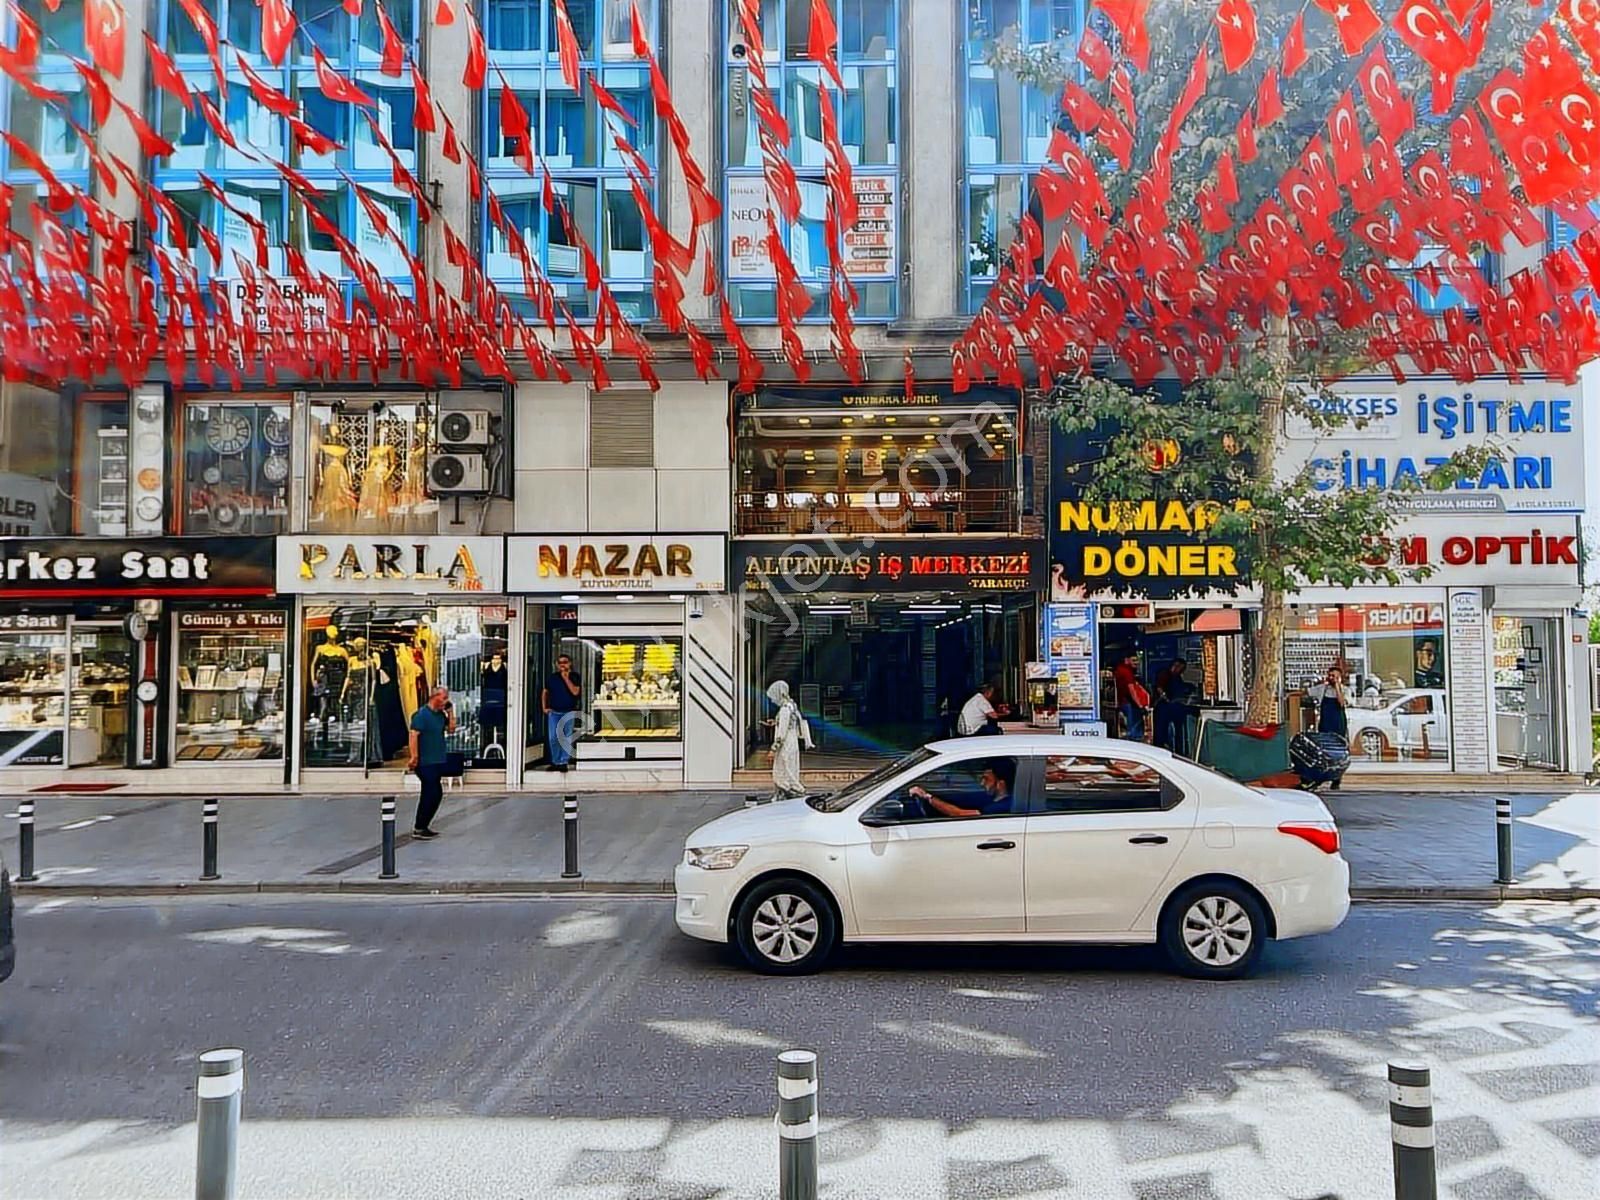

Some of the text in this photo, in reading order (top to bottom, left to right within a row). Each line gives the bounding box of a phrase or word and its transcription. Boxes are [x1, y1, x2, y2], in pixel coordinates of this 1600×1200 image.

[1309, 398, 1398, 416] PAKSES
[1418, 393, 1572, 439] İŞİTME
[1060, 500, 1257, 532] NUMAR
[298, 543, 481, 580] PARLA
[538, 543, 694, 578] NAZAR
[1083, 540, 1239, 577] DÖNER
[1441, 529, 1579, 565] OPTİK
[0, 550, 209, 580] rkez Saat
[745, 551, 1030, 580] ALTINTAŞ İŞ MERKEZİ
[16, 614, 58, 628] Saat
[182, 614, 232, 628] Gümüş
[236, 614, 247, 625] &
